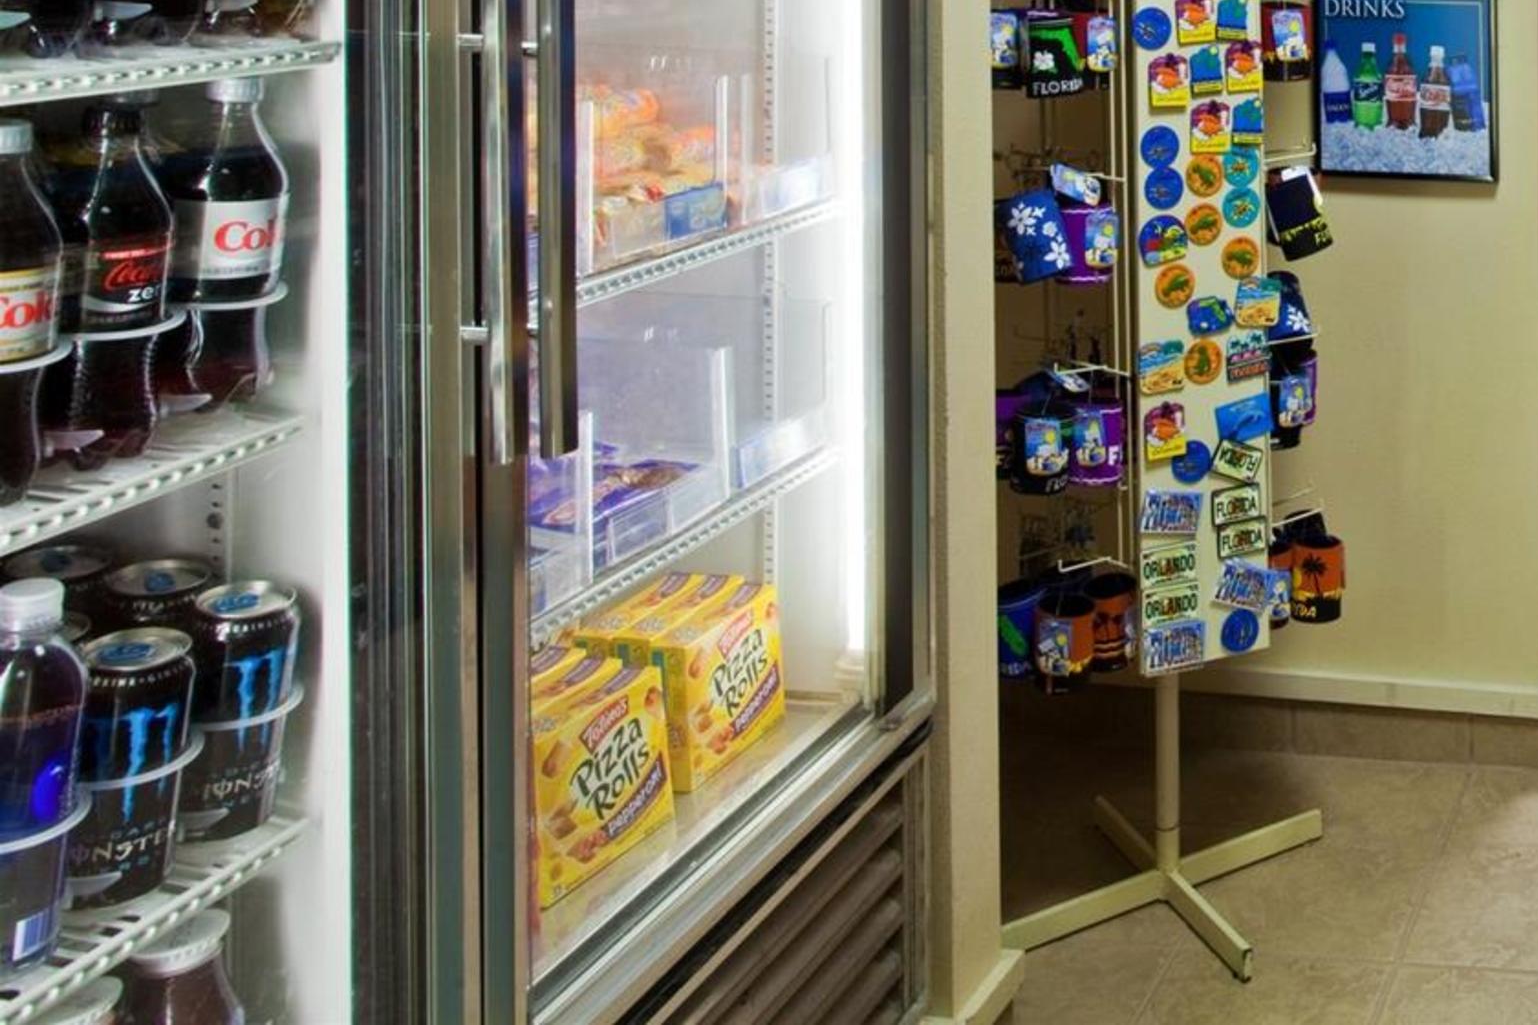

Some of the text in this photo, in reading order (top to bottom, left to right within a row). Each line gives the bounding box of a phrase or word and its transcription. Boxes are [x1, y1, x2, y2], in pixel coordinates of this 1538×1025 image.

[1216, 497, 1256, 518] FLORIDA
[1222, 529, 1263, 552] FLORIDA
[1143, 553, 1196, 579] ORLANDO
[1145, 593, 1198, 619] ORLANDO
[712, 628, 762, 698] Pizza
[723, 651, 768, 718] Rolls
[570, 717, 643, 797] Pizza
[586, 742, 651, 821] Rolls
